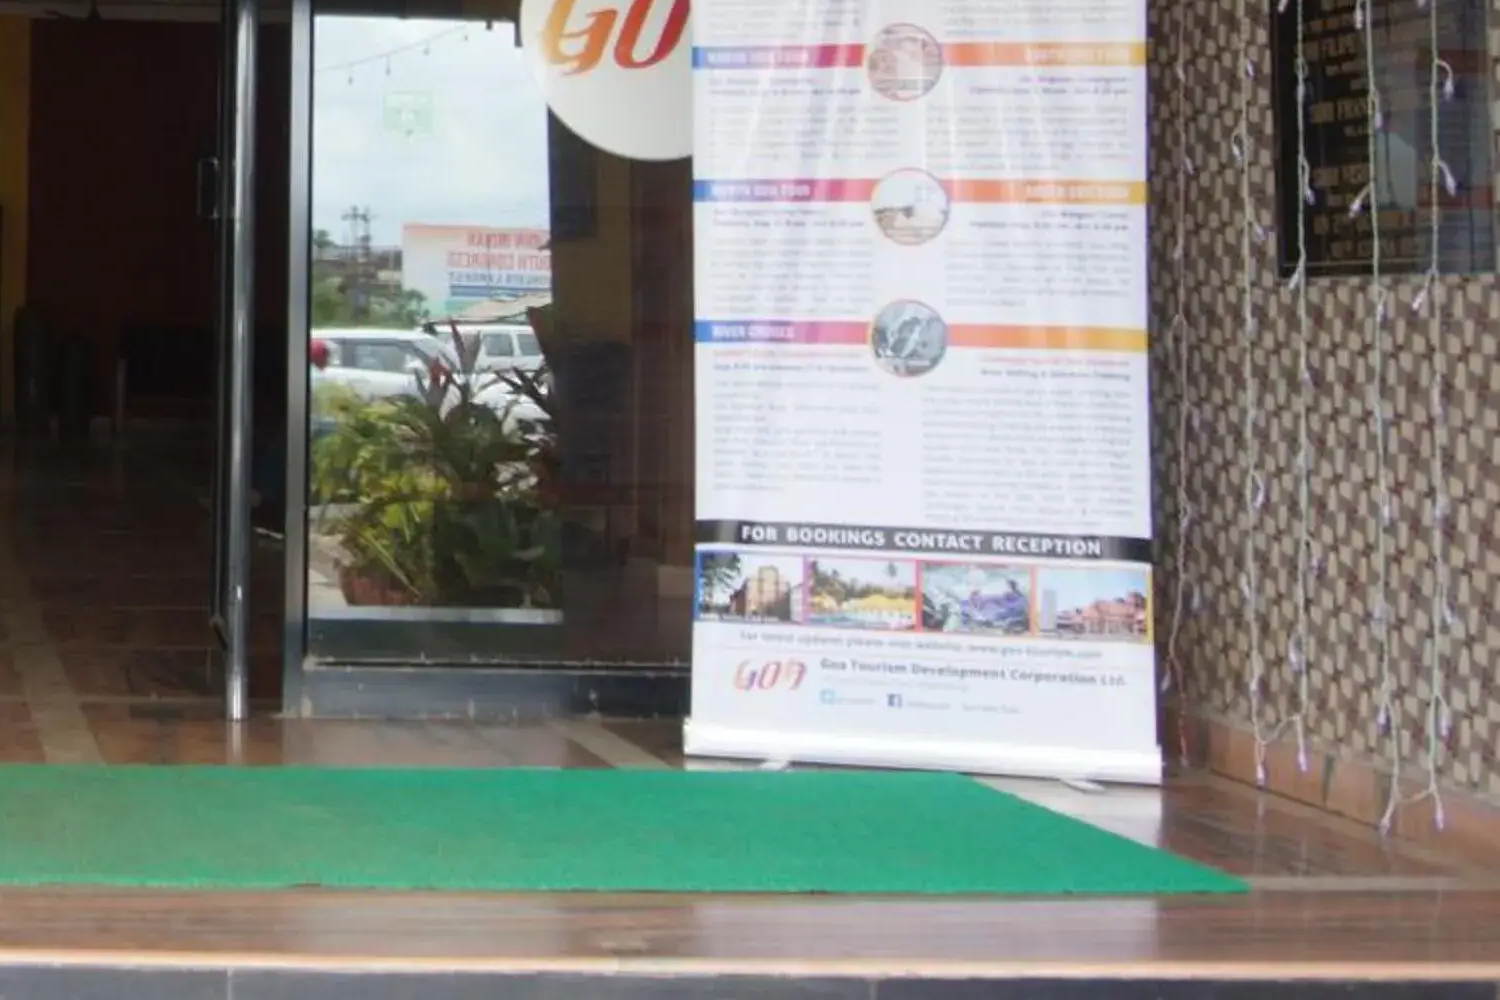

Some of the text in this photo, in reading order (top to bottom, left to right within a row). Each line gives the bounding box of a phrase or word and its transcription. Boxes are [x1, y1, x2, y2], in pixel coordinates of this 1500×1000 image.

[741, 525, 1102, 555] FOR BOOKINGS CONTACT RECEPTION
[820, 658, 847, 671] Goa
[851, 659, 907, 675] Tourism
[911, 663, 1006, 680] Development
[1010, 669, 1097, 685] Corporation
